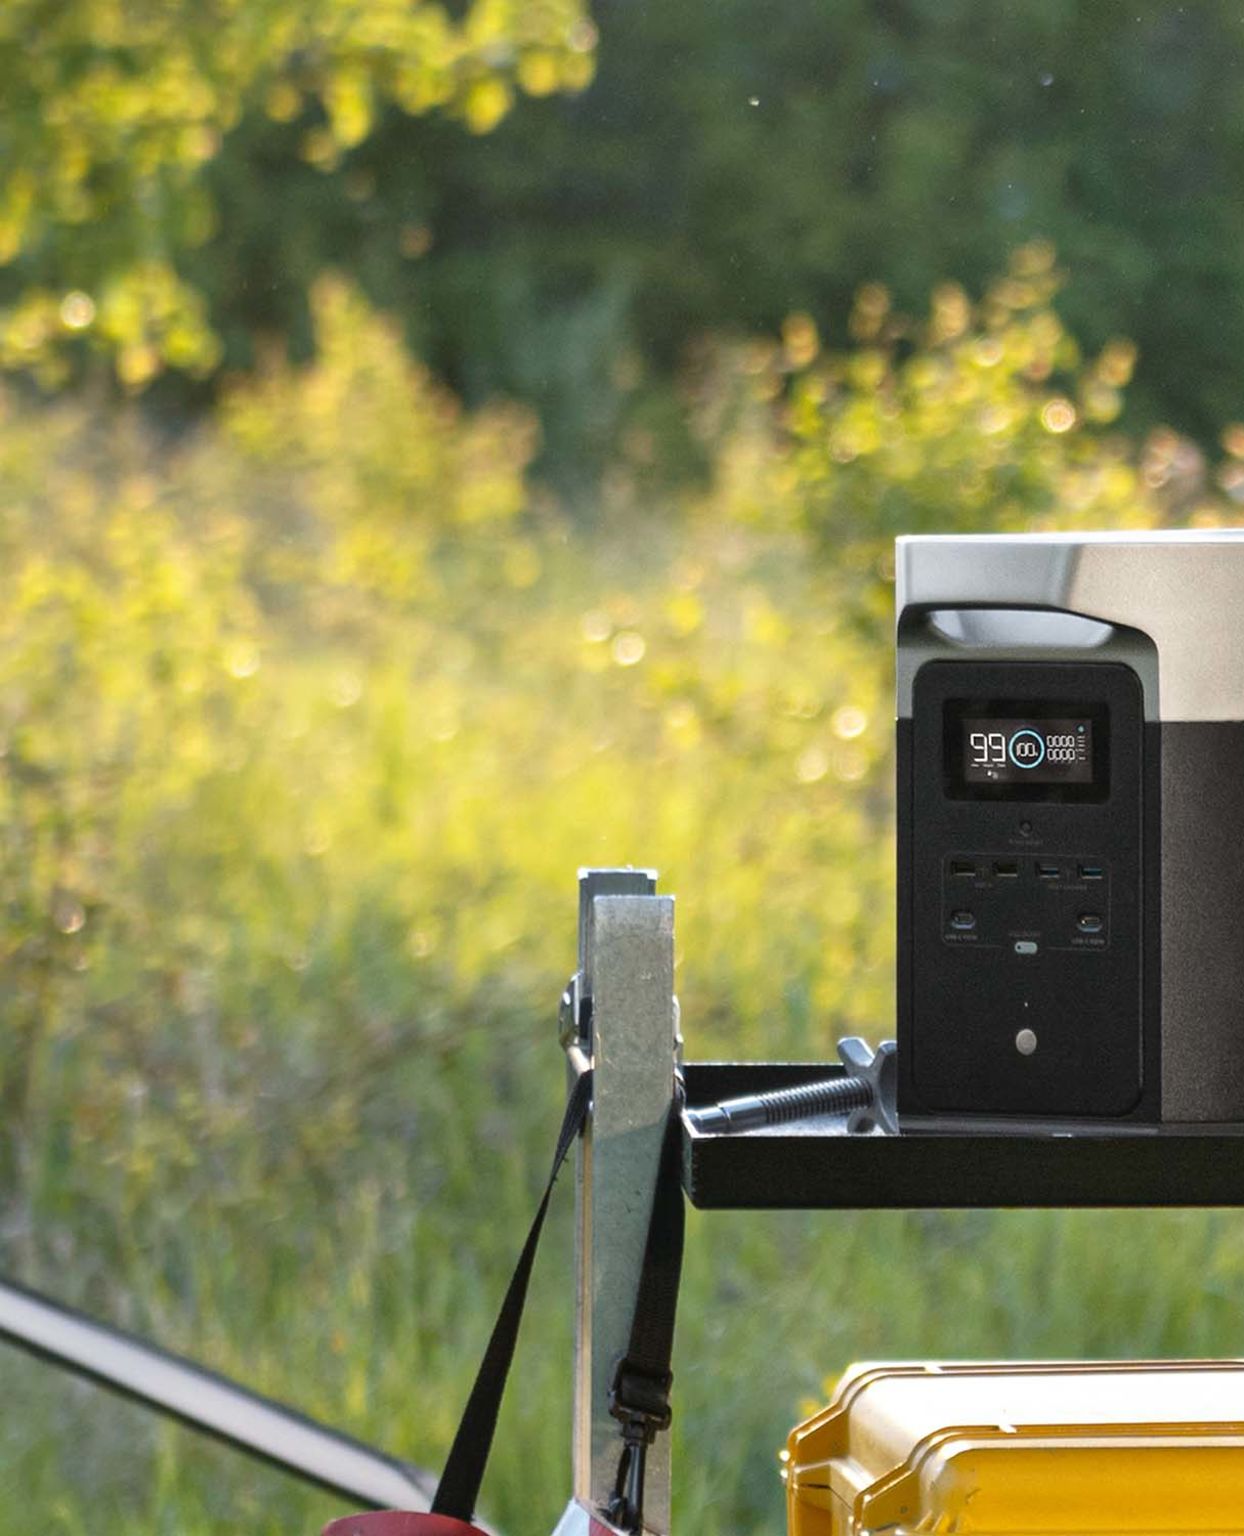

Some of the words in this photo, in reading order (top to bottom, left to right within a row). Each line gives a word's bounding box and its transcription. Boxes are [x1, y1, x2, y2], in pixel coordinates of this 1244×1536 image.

[970, 733, 1006, 762] 99
[1046, 735, 1075, 748] 0000
[1046, 748, 1075, 760] 0000
